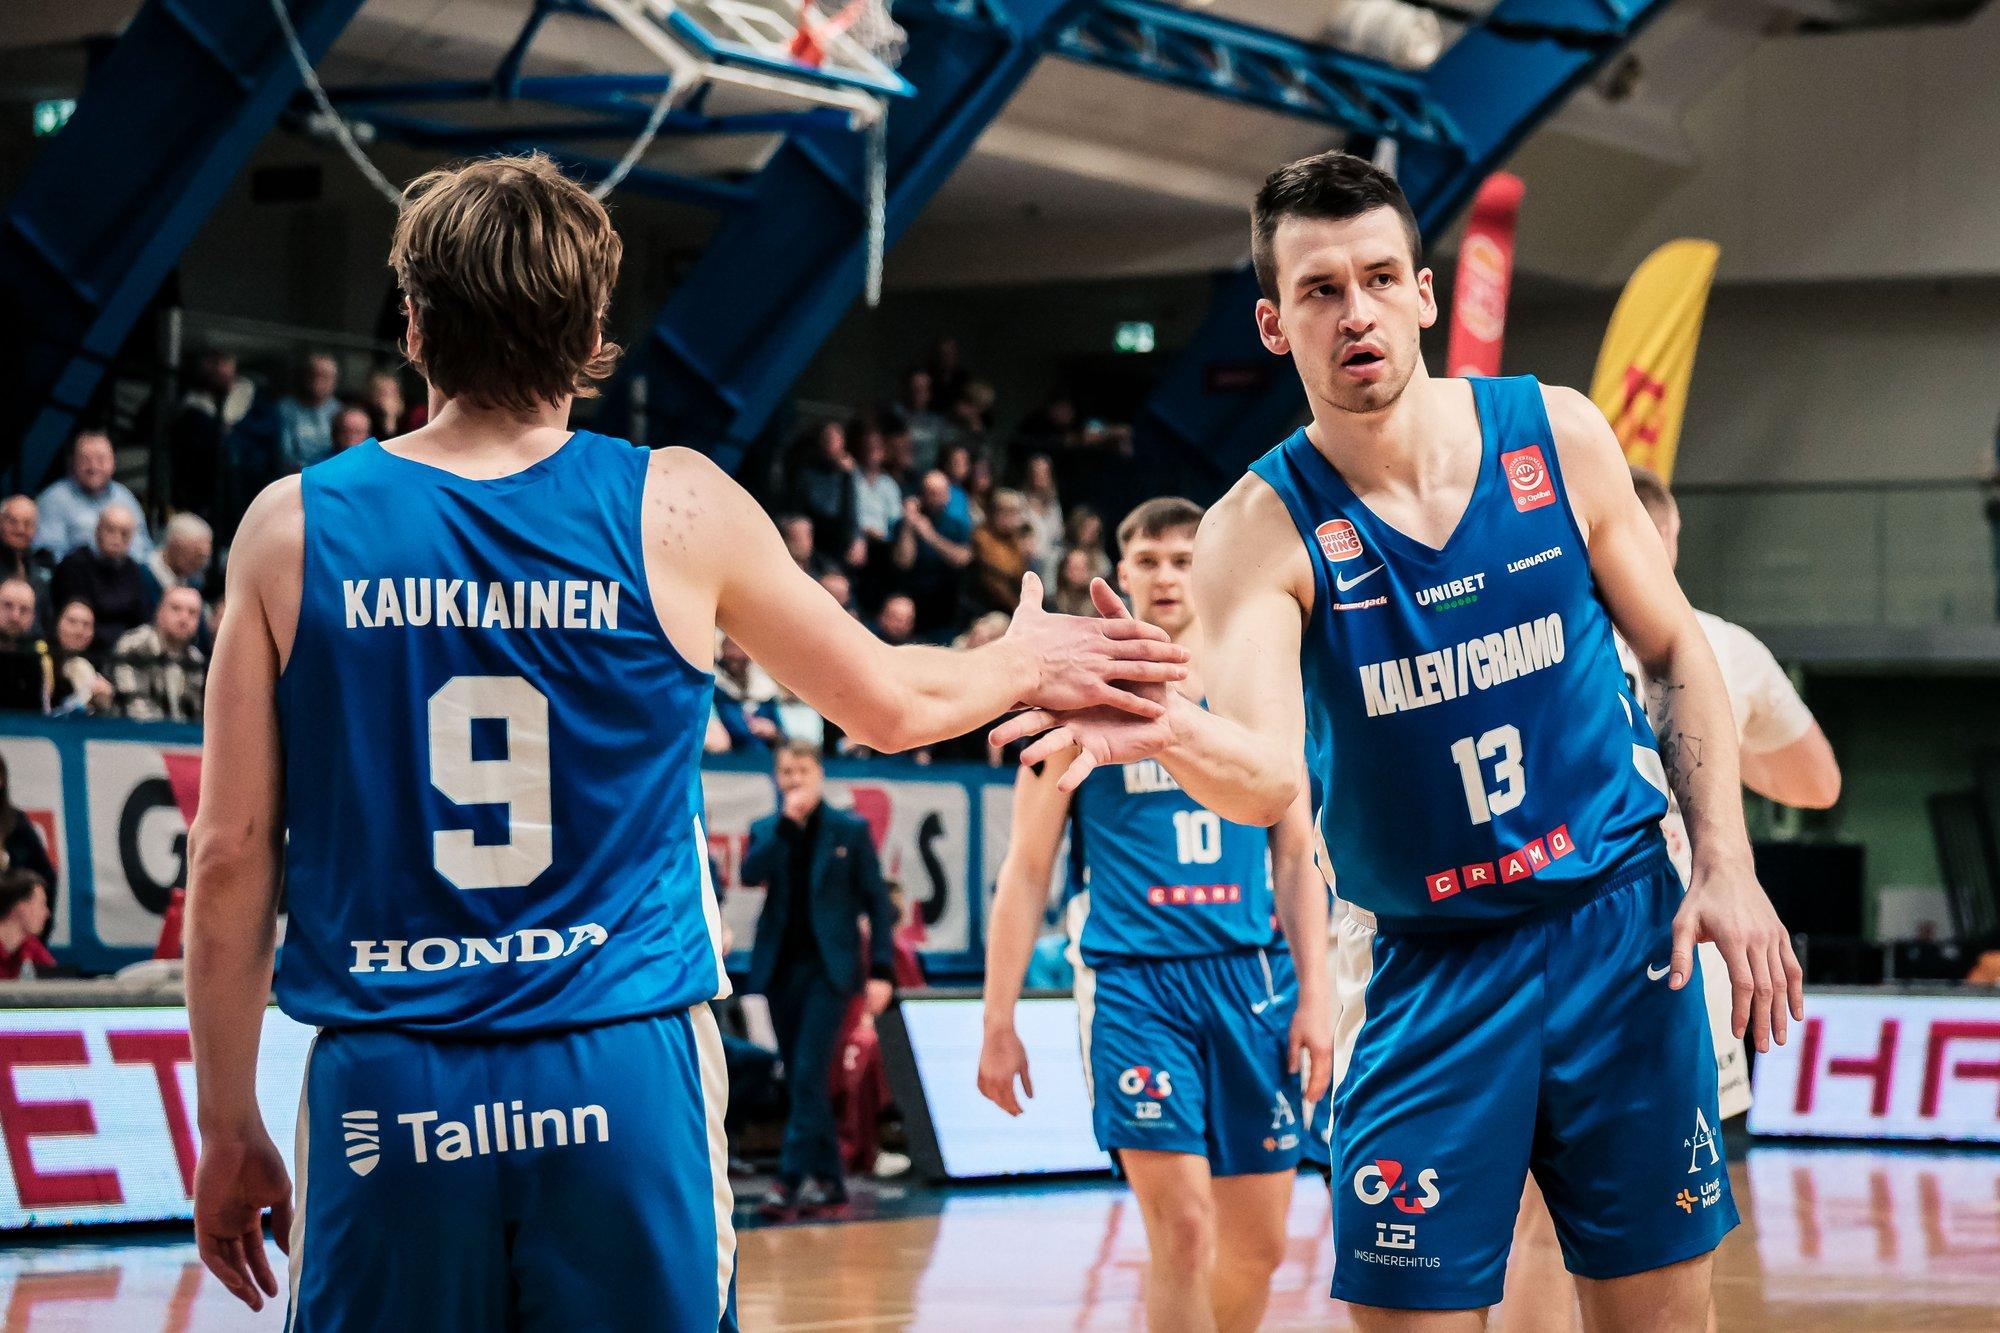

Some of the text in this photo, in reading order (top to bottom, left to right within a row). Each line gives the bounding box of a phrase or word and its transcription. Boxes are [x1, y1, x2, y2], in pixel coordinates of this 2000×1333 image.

[1319, 529, 1356, 544] BURGER
[1322, 537, 1360, 555] KING
[1506, 546, 1563, 574] LIGNATOR
[343, 577, 620, 630] KAUKIAINEN
[1415, 572, 1486, 606] UNIBET
[1359, 612, 1566, 717] KALEV/CRAMO
[428, 675, 553, 890] 9
[1451, 723, 1527, 825] 13
[1172, 810, 1223, 864] 10
[1433, 831, 1568, 894] CRAMO
[348, 922, 609, 973] HONDA
[398, 1100, 610, 1164] Tallinn
[1354, 1159, 1441, 1214] G4S
[1354, 1248, 1441, 1269] INSENEREHITUS
